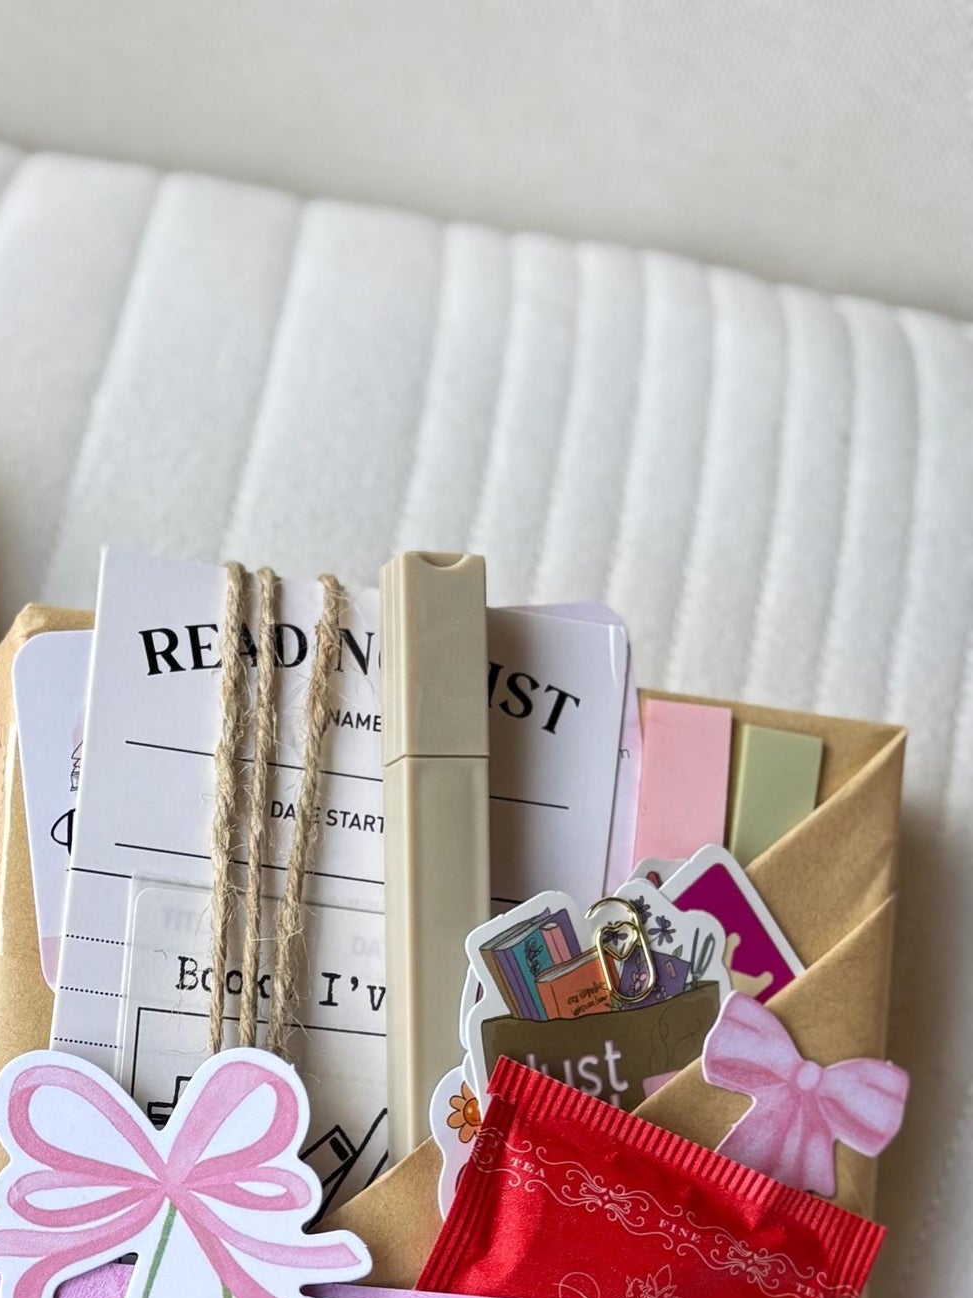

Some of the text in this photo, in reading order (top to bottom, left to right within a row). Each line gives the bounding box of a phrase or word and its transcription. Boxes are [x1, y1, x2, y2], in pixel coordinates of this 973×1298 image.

[138, 623, 581, 734] READN IST
[271, 801, 321, 824] DAE
[175, 956, 386, 1012] Boo I'v
[527, 1040, 629, 1096] st
[511, 1157, 546, 1178] TEA
[659, 1218, 702, 1244] FINE
